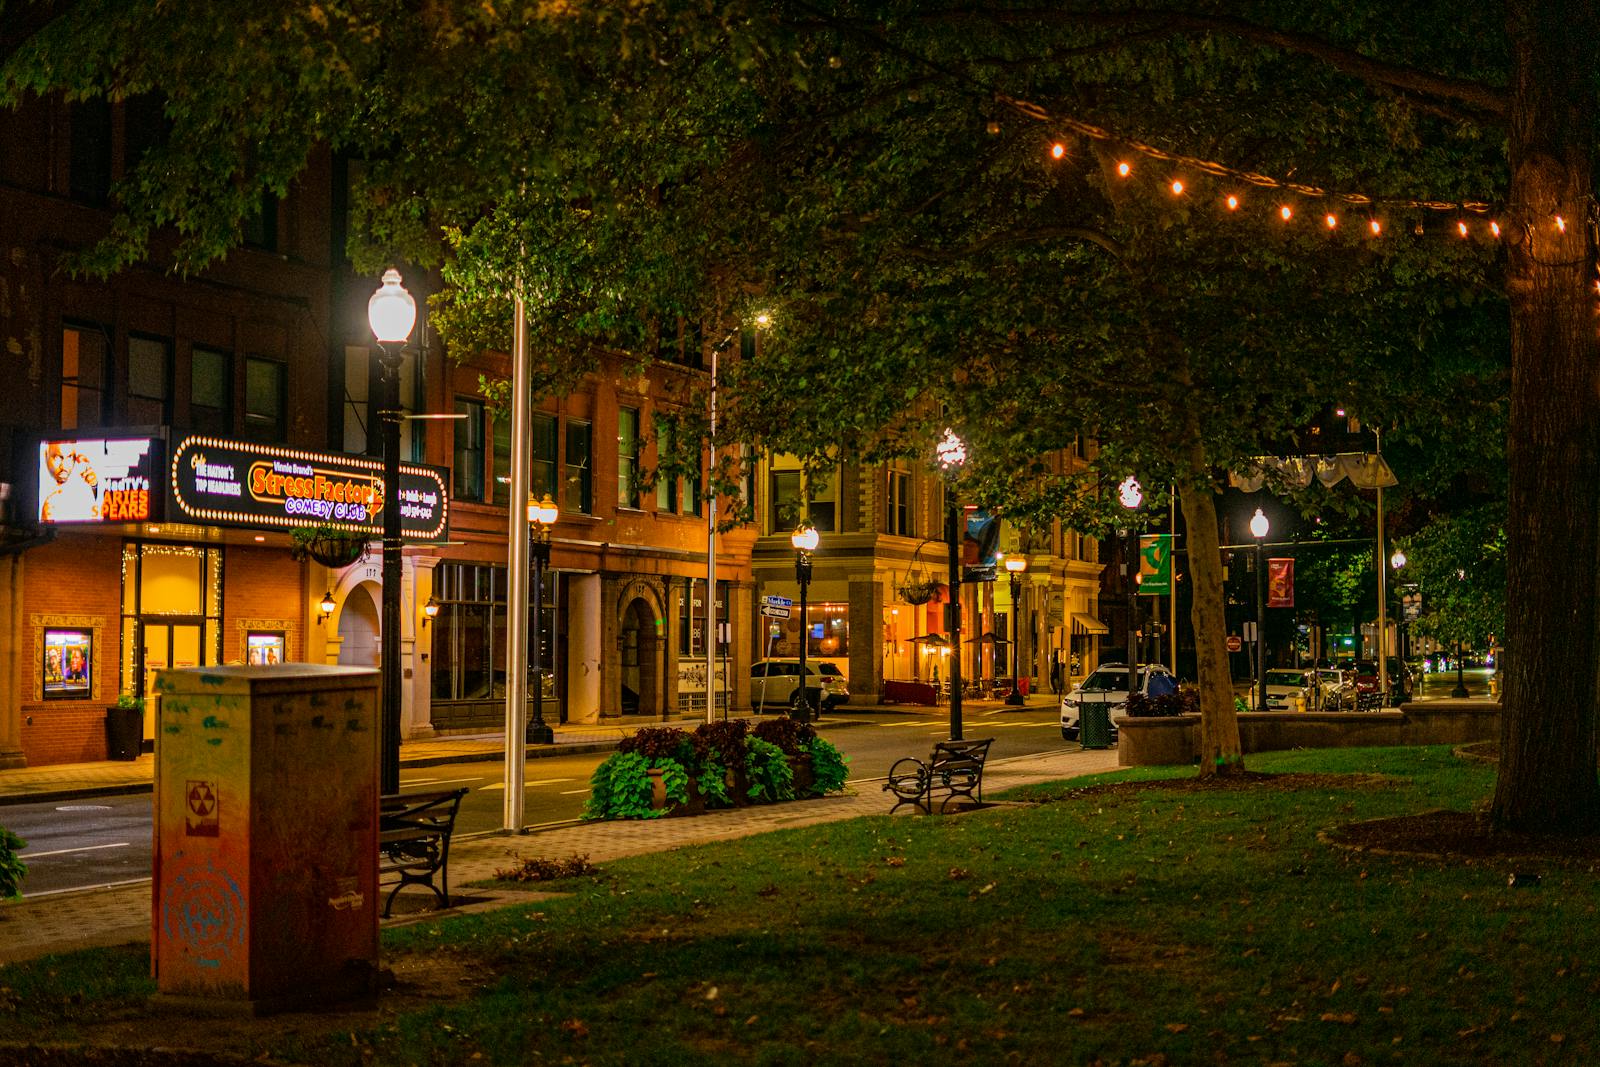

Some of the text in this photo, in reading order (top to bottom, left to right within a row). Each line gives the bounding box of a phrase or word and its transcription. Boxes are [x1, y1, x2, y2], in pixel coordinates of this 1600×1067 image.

[196, 463, 235, 480] THE NATION'S
[273, 461, 313, 476] Vinnie Brand's
[102, 477, 149, 491] MadTV's
[195, 478, 241, 497] TOP HEADLINERS
[253, 467, 314, 498] Stress
[103, 490, 149, 505] ARIES
[91, 503, 149, 520] SPEARS
[284, 497, 366, 520] COMEDY CLUB
[692, 599, 701, 608] FOR
